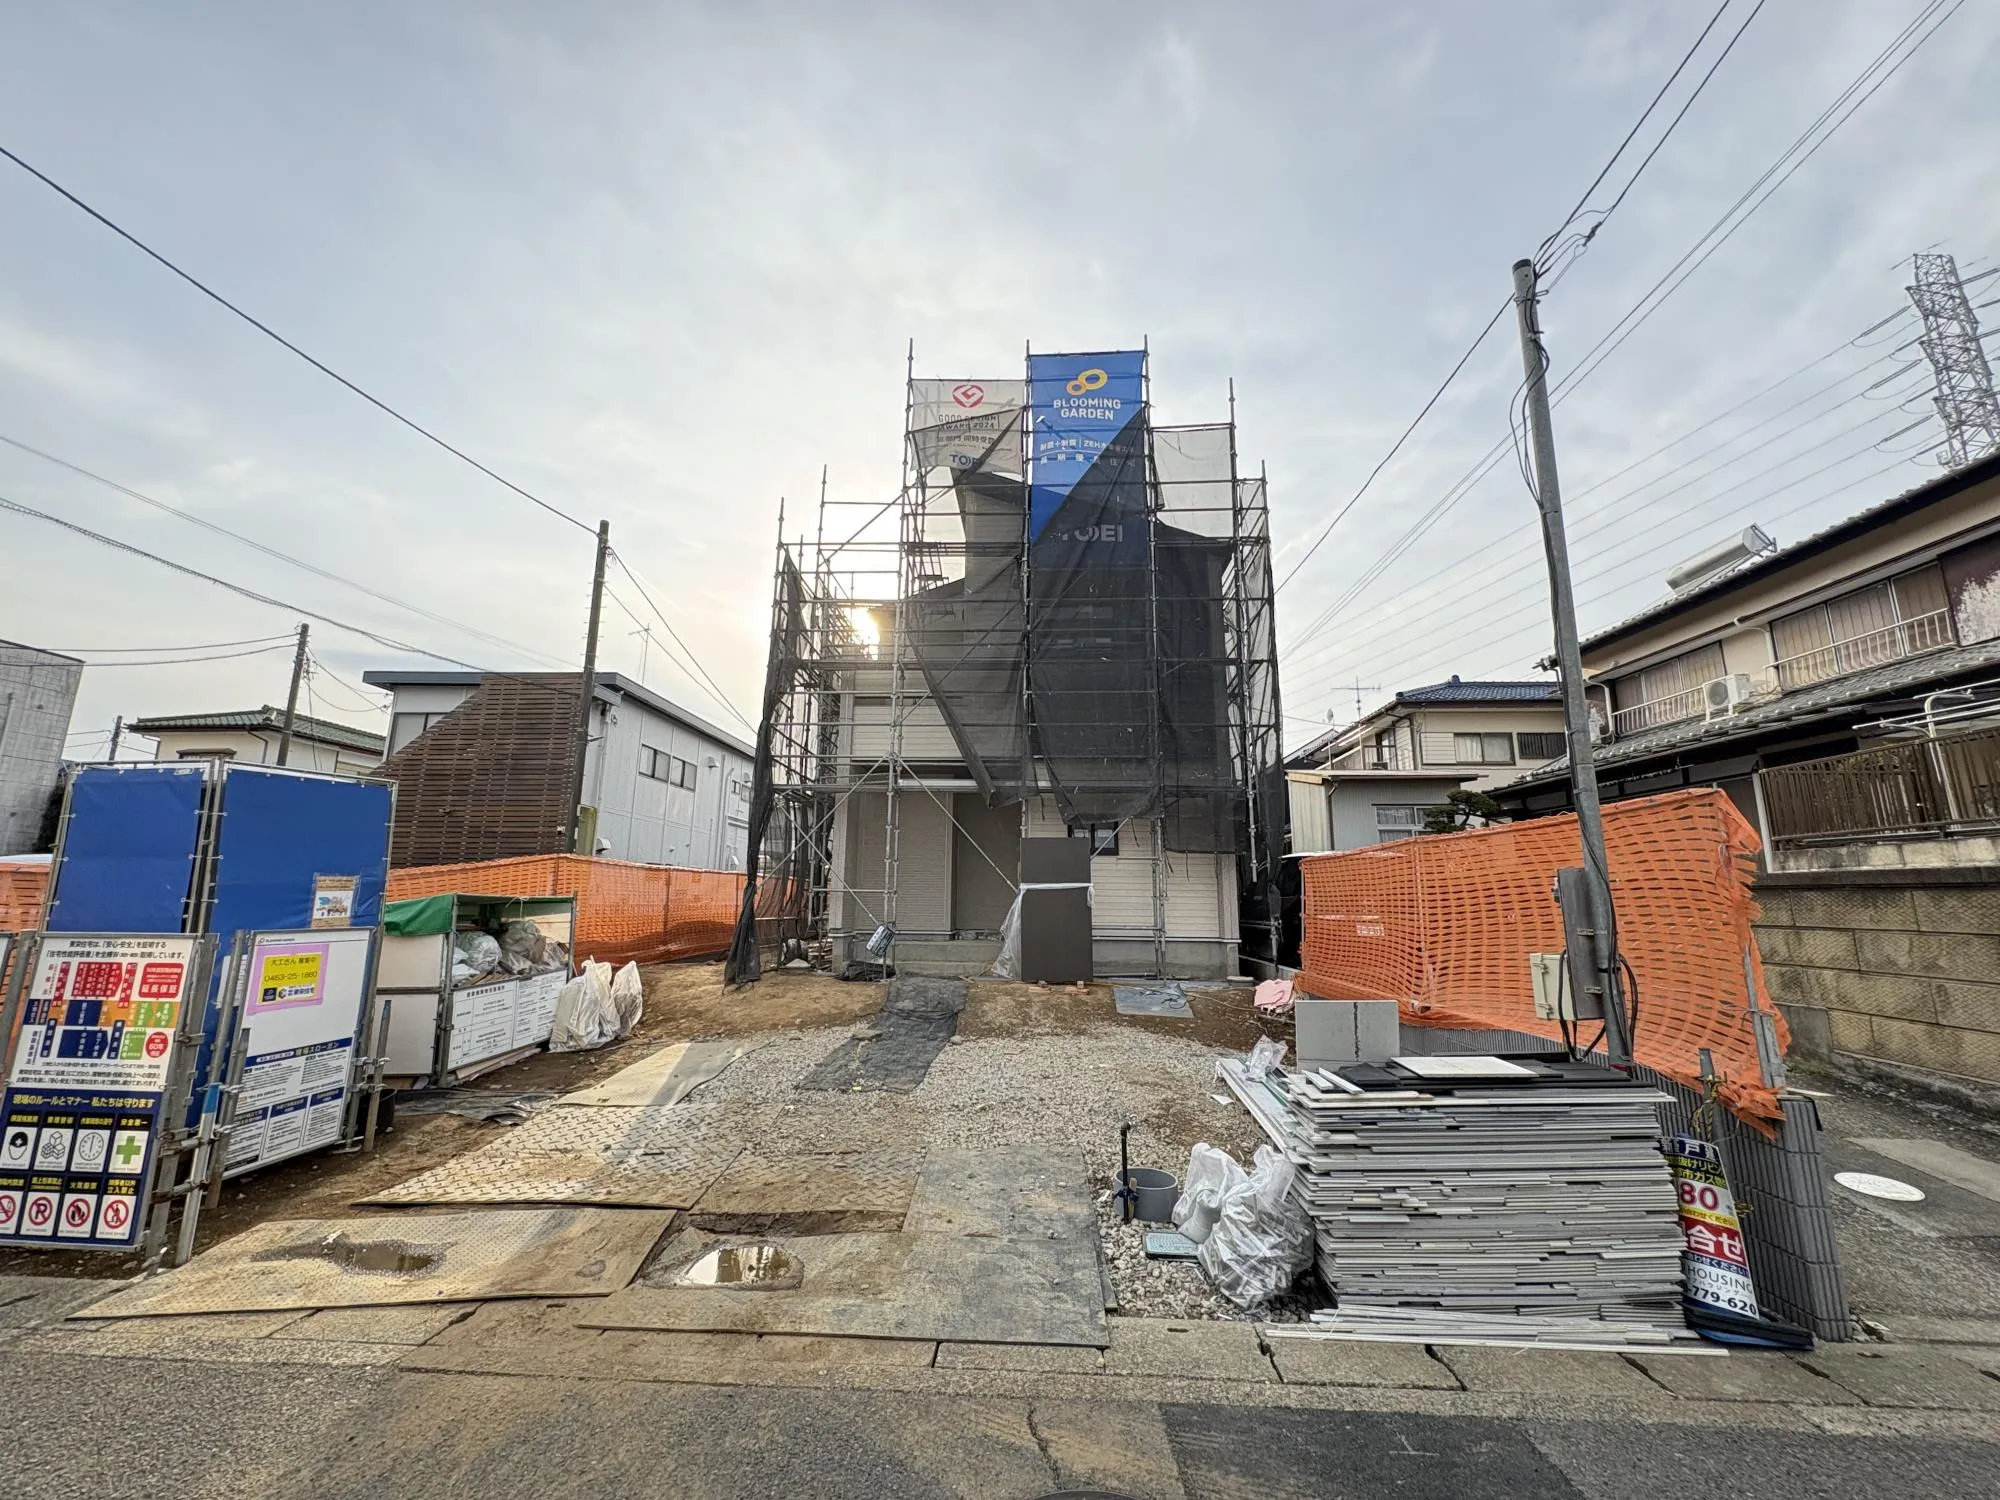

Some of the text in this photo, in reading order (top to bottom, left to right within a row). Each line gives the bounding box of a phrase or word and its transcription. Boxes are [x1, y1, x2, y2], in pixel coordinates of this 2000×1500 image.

[1053, 397, 1121, 410] BLOOMING
[1060, 408, 1114, 421] GARDEN
[973, 421, 995, 430] 2024
[91, 1097, 156, 1109] 私たちは守ります
[1680, 1181, 1719, 1211] 80
[1685, 1224, 1743, 1263] 合せ
